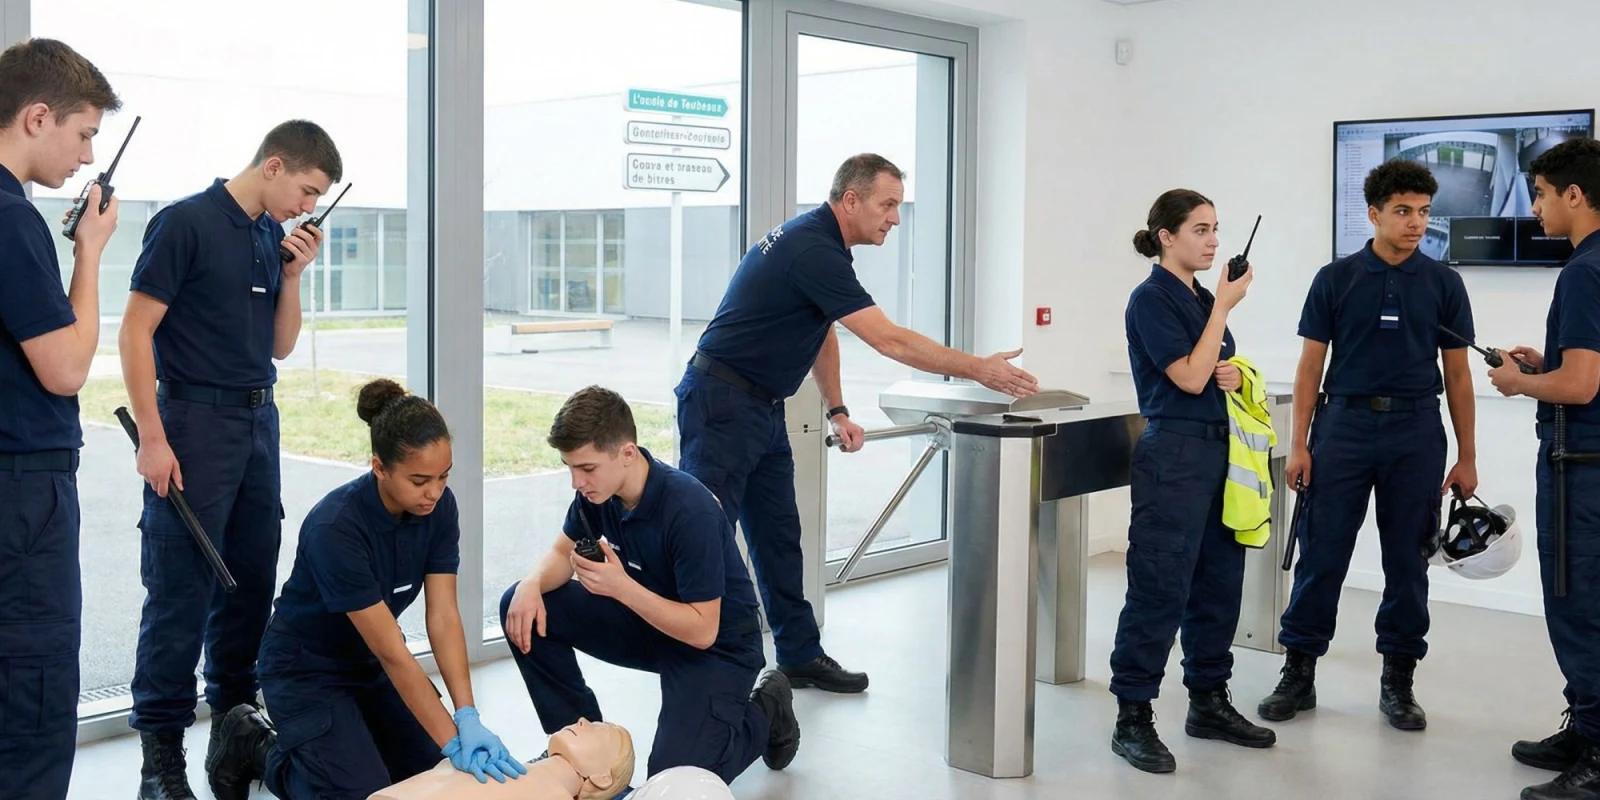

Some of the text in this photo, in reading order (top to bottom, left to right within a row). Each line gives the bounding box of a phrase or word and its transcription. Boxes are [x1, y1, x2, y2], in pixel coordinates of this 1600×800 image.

[667, 97, 678, 108] de
[665, 162, 674, 171] et
[632, 173, 644, 183] de
